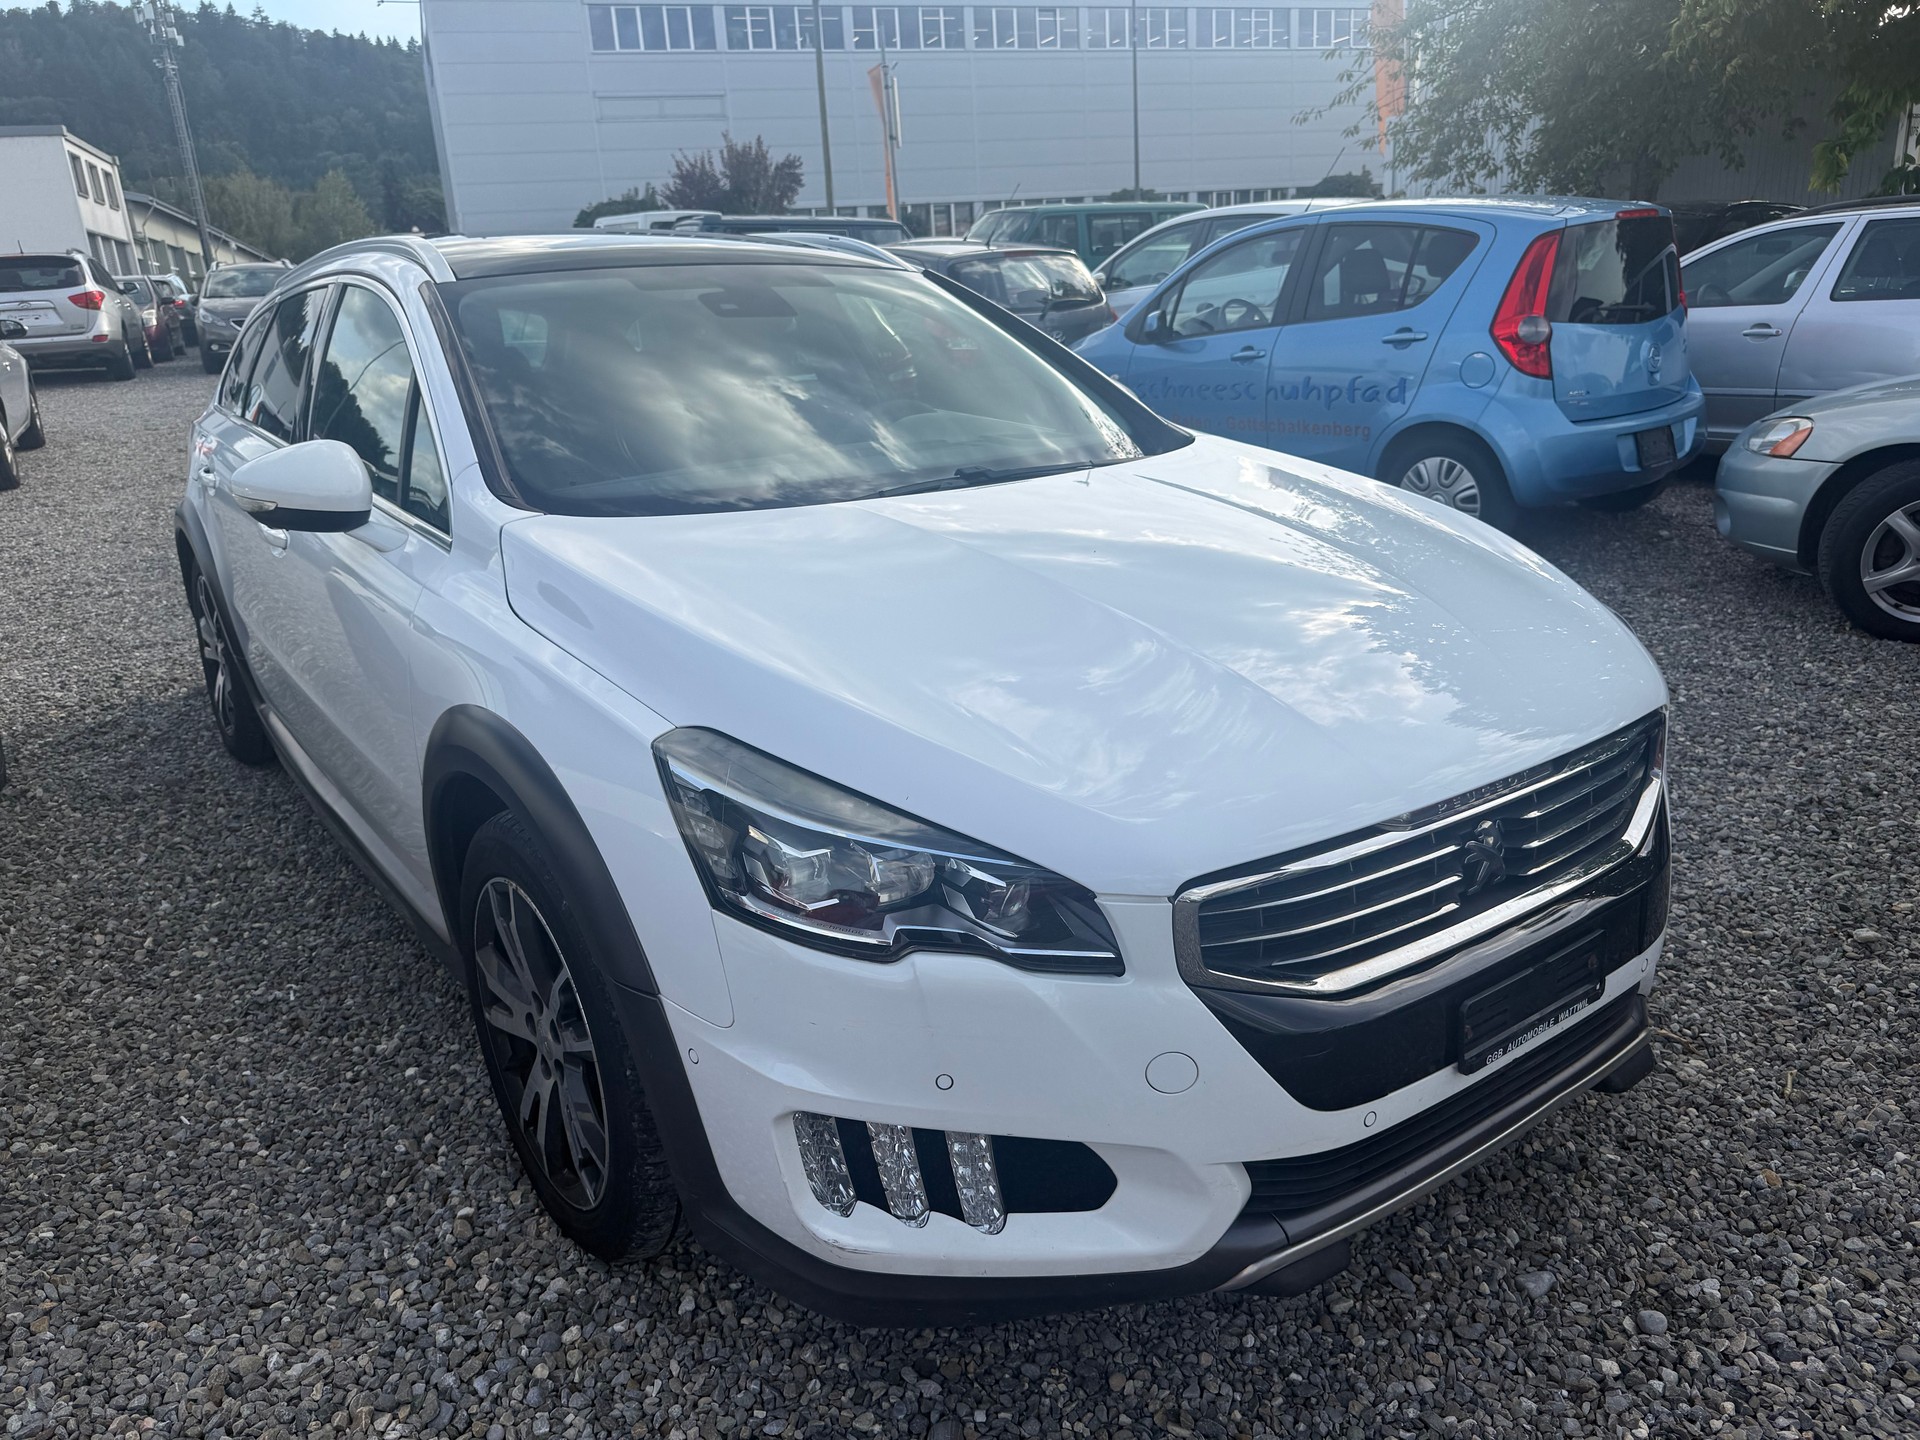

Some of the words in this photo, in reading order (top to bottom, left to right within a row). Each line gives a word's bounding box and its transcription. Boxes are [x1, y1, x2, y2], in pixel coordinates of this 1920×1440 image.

[1226, 415, 1371, 441] Gottschalkenberg
[1486, 1048, 1503, 1065] GGB
[1507, 1017, 1555, 1052] AUTOMOBILE
[1558, 998, 1589, 1023] WATTWIL
